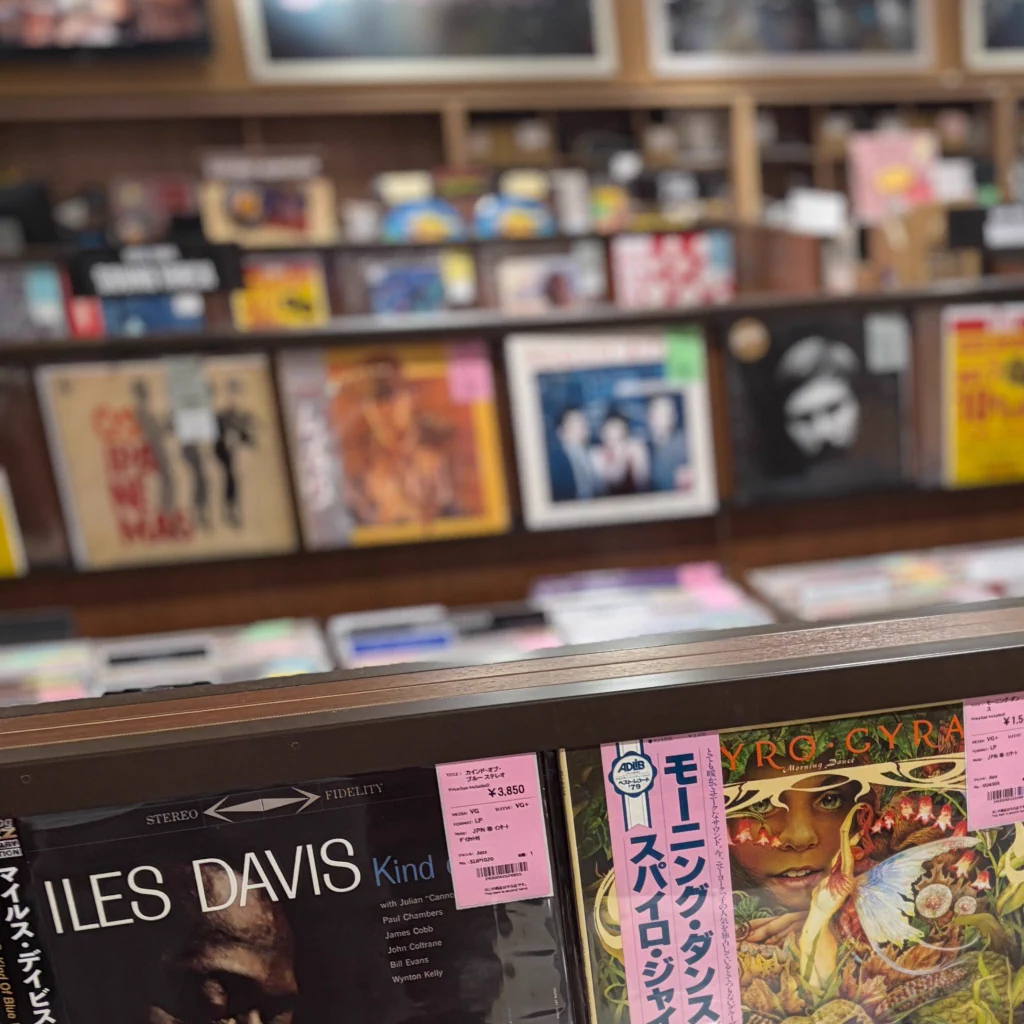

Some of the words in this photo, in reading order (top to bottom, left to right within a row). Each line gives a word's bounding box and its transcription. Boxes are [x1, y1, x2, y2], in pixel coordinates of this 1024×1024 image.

[720, 734, 817, 772] YRO
[488, 784, 525, 798] ¥3,850
[146, 808, 199, 826] STEREO
[324, 783, 384, 800] FIDELITY
[44, 865, 172, 934] ILES
[192, 838, 361, 913] DAVIS
[372, 855, 434, 887] Kind
[380, 900, 397, 909] with
[399, 897, 423, 907] Julian
[382, 915, 401, 924] Paul
[403, 909, 444, 921] Chambers
[385, 930, 411, 940] James
[413, 925, 434, 935] Cobb
[388, 945, 407, 954] John
[409, 940, 443, 951] Coltrane
[390, 960, 403, 969] Bill
[405, 957, 429, 967] Evans
[392, 974, 422, 984] Wynton
[424, 969, 444, 979] Kelly
